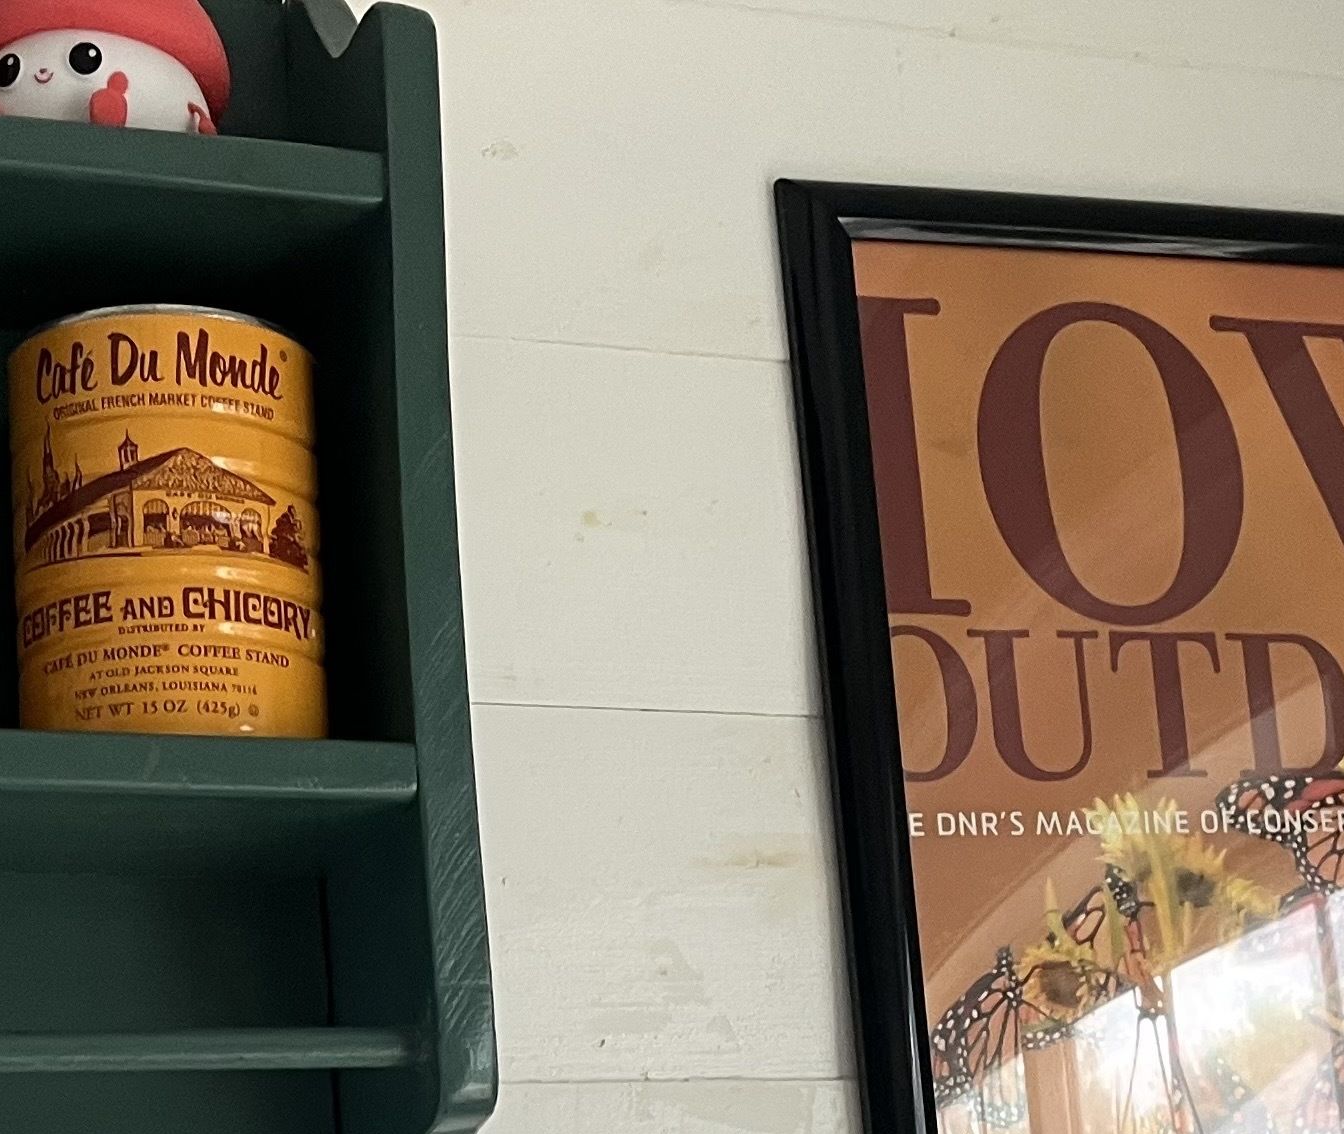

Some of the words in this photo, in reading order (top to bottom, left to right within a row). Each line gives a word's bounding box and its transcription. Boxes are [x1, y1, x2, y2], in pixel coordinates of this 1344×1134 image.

[36, 341, 98, 405] Café
[107, 332, 165, 387] Du
[53, 398, 99, 421] ORIGINAL
[101, 393, 145, 410] FRENCH
[148, 393, 197, 407] MARKET
[243, 400, 274, 420] STAND
[23, 590, 113, 649] COFFEE
[121, 596, 175, 621] AND
[182, 587, 313, 640] CHICORY
[118, 624, 189, 635] DISTRIBUTED
[193, 624, 206, 633] BY
[76, 650, 98, 667] DU
[178, 644, 241, 660] COFFEE
[245, 649, 290, 668] STAND
[89, 670, 103, 680] AT
[105, 667, 130, 678] OLD
[135, 664, 190, 676] JACKSON
[193, 664, 239, 676] SQUARE
[74, 687, 98, 700] NEW
[162, 681, 228, 693] LOUISIANA
[76, 705, 103, 720] NET
[109, 701, 134, 718] WT
[142, 701, 158, 714] 15
[163, 699, 188, 714] OZ
[937, 811, 1025, 837] DNR'S
[1036, 808, 1190, 836] MAGAZINE
[1200, 808, 1236, 834] OF
